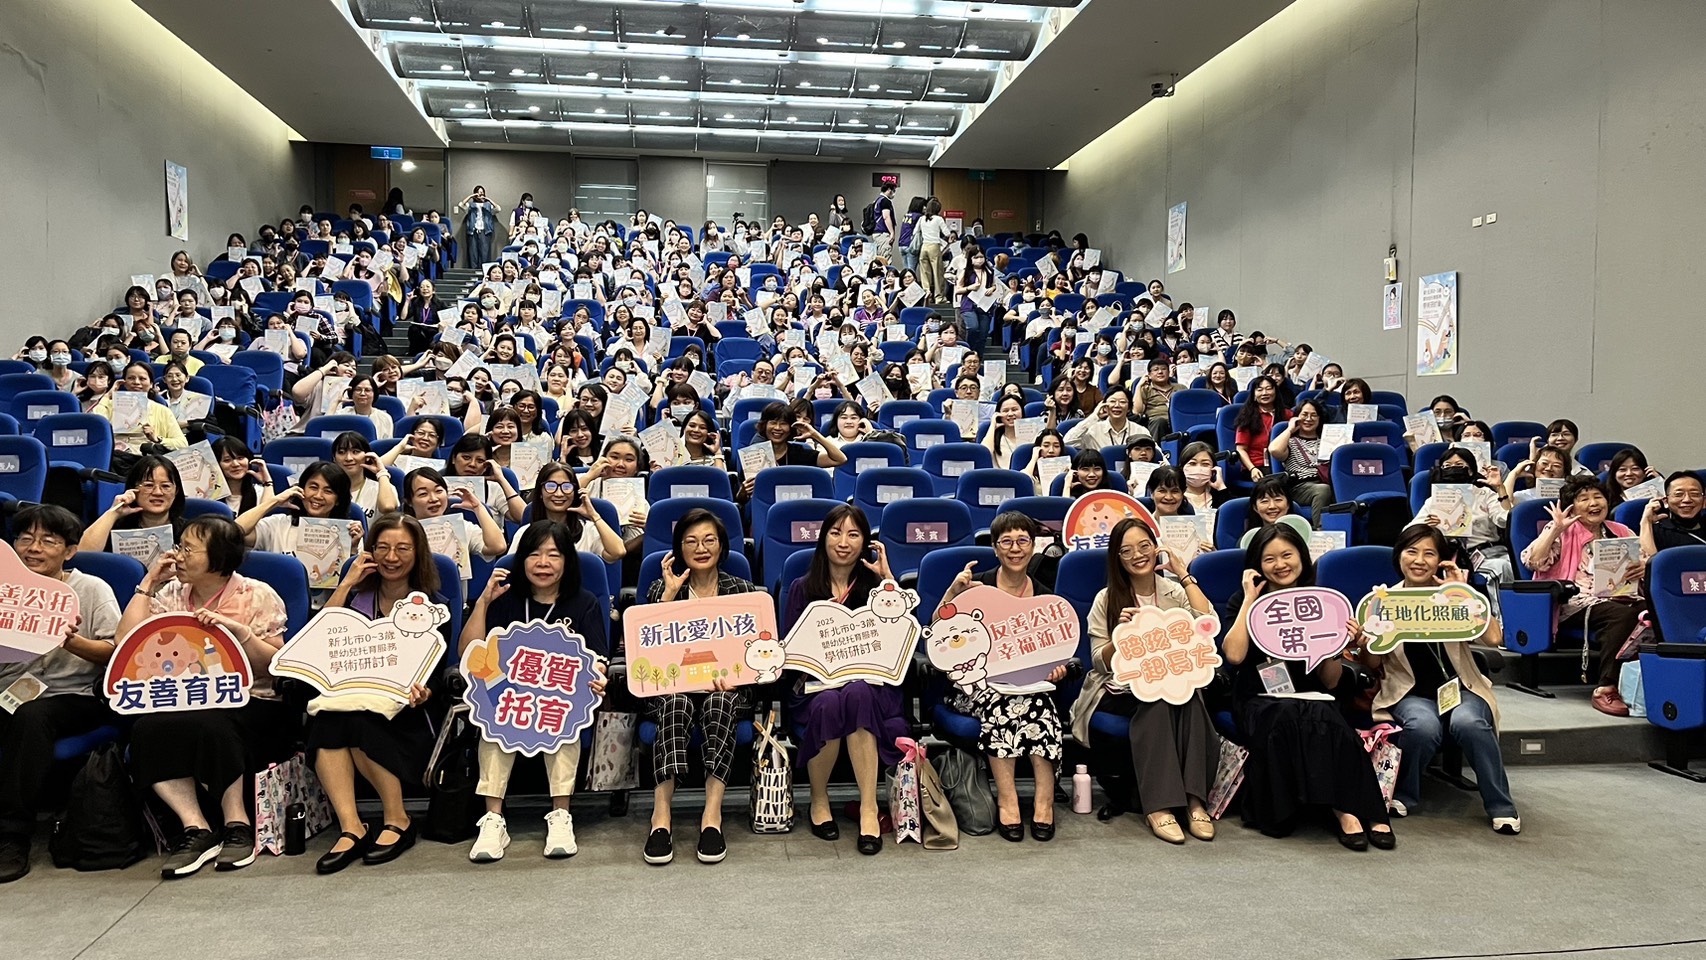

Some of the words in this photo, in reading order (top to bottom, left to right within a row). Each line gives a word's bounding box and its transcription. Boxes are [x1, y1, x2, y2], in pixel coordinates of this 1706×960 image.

[915, 530, 939, 541] 來賓
[1690, 581, 1706, 592] 來
[816, 617, 835, 627] 2025
[989, 601, 1069, 641] 友善公托
[1264, 595, 1324, 626] 全國
[1377, 604, 1471, 622] 在地化照顧
[327, 625, 349, 635] 2025
[640, 613, 758, 647] 新北愛小孩
[997, 621, 1077, 661] 幸福新北
[1117, 620, 1194, 661] 陪孩子
[1278, 626, 1338, 654] 第一
[328, 642, 398, 660] 嬰幼兒托育服務
[330, 653, 399, 674] 學術研討會
[824, 640, 882, 664] 學術研討會
[1117, 643, 1219, 684] 一起長大
[509, 648, 580, 693] 優質
[116, 676, 244, 709] 友善育兒
[498, 691, 571, 733] 托育
